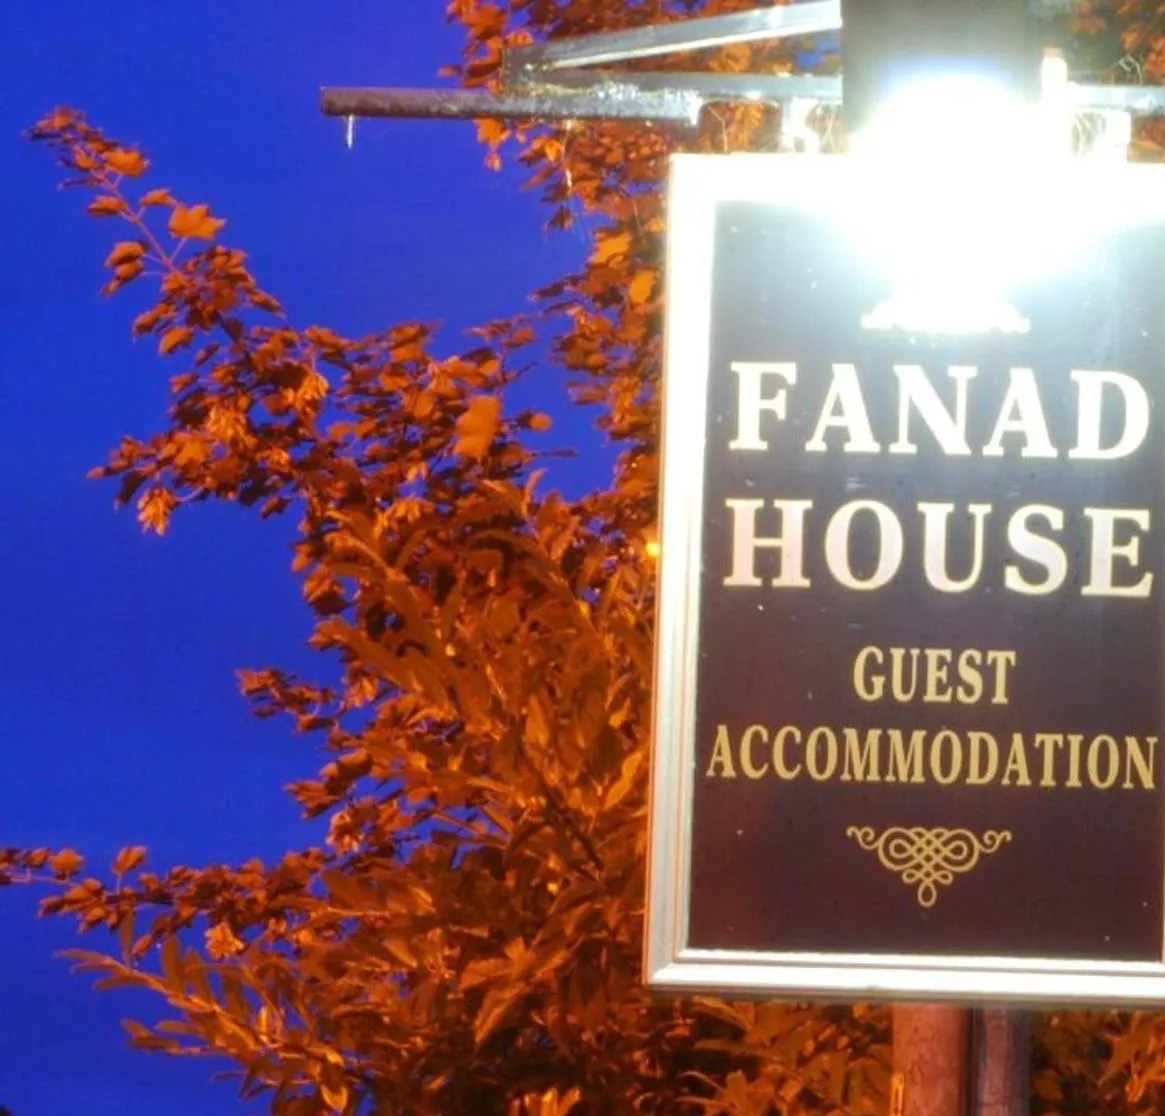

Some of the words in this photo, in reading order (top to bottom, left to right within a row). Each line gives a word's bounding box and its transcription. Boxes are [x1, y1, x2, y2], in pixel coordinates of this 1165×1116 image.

[727, 360, 1152, 462] FANAD
[722, 498, 1155, 598] HOUSE
[852, 645, 1018, 705] GUEST
[705, 724, 1160, 791] ACCOMMODATION
